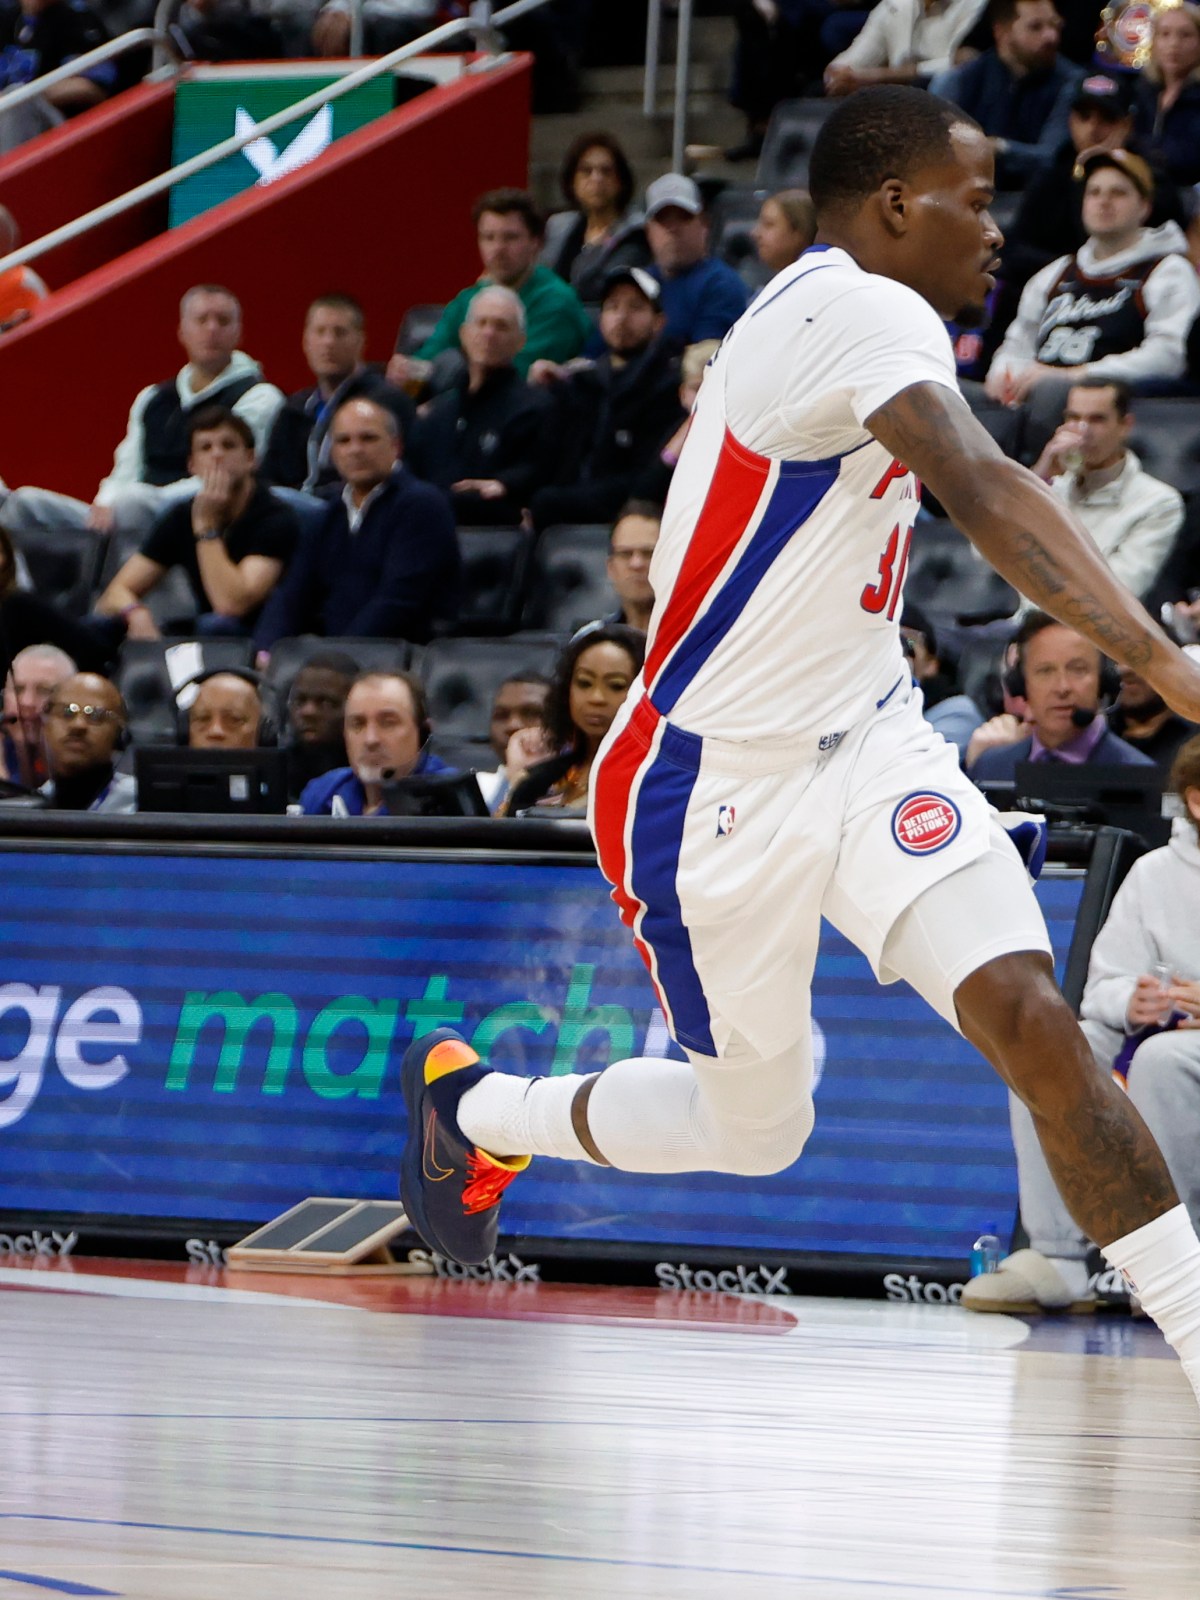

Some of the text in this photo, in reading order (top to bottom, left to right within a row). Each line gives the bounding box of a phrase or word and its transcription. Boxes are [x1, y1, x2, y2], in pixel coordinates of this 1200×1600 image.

[902, 805, 945, 831] DETROIT
[905, 814, 950, 841] PISTONS
[654, 1262, 793, 1295] StockX
